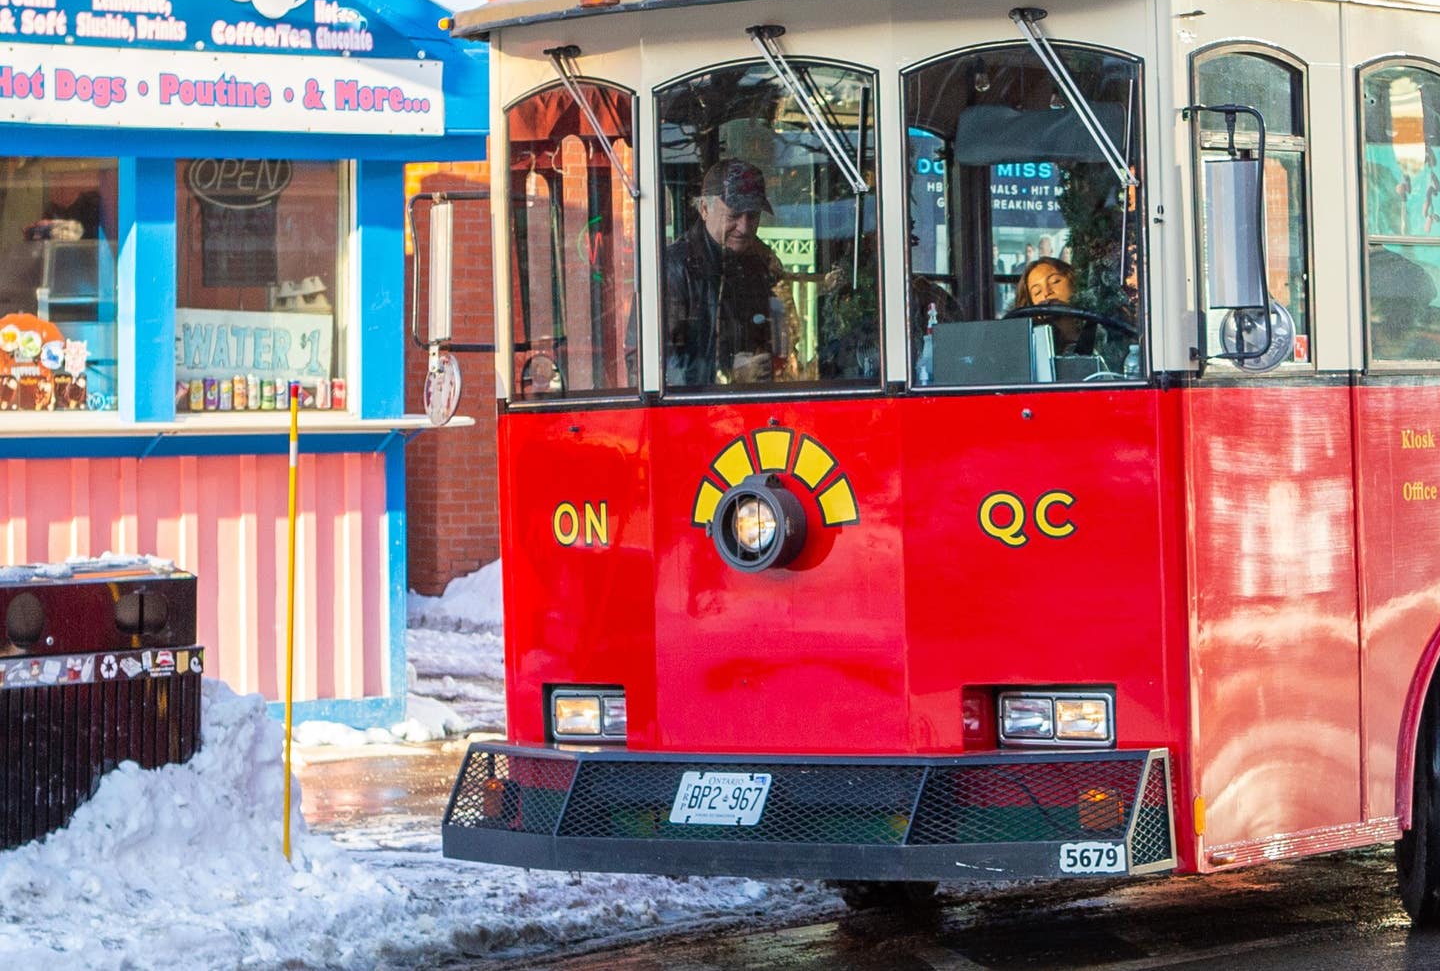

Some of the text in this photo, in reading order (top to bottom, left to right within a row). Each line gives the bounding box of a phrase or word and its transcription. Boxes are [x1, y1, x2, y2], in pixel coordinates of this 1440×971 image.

[21, 8, 67, 36] Soft
[314, 0, 339, 23] Hot
[136, 15, 187, 42] Drinks
[315, 26, 374, 52] Chocolate
[54, 69, 127, 108] Dogs
[160, 72, 271, 108] Poutine
[303, 78, 327, 110] &
[195, 159, 282, 190] OPEN
[997, 162, 1053, 178] MISS
[1031, 185, 1050, 196] HIT
[183, 322, 292, 370] WATER
[300, 329, 327, 376] $1
[1401, 429, 1436, 449] Kiosk
[1403, 482, 1438, 501] Office
[553, 500, 608, 547] ON
[979, 490, 1078, 547] QC
[1066, 848, 1118, 868] 5679
